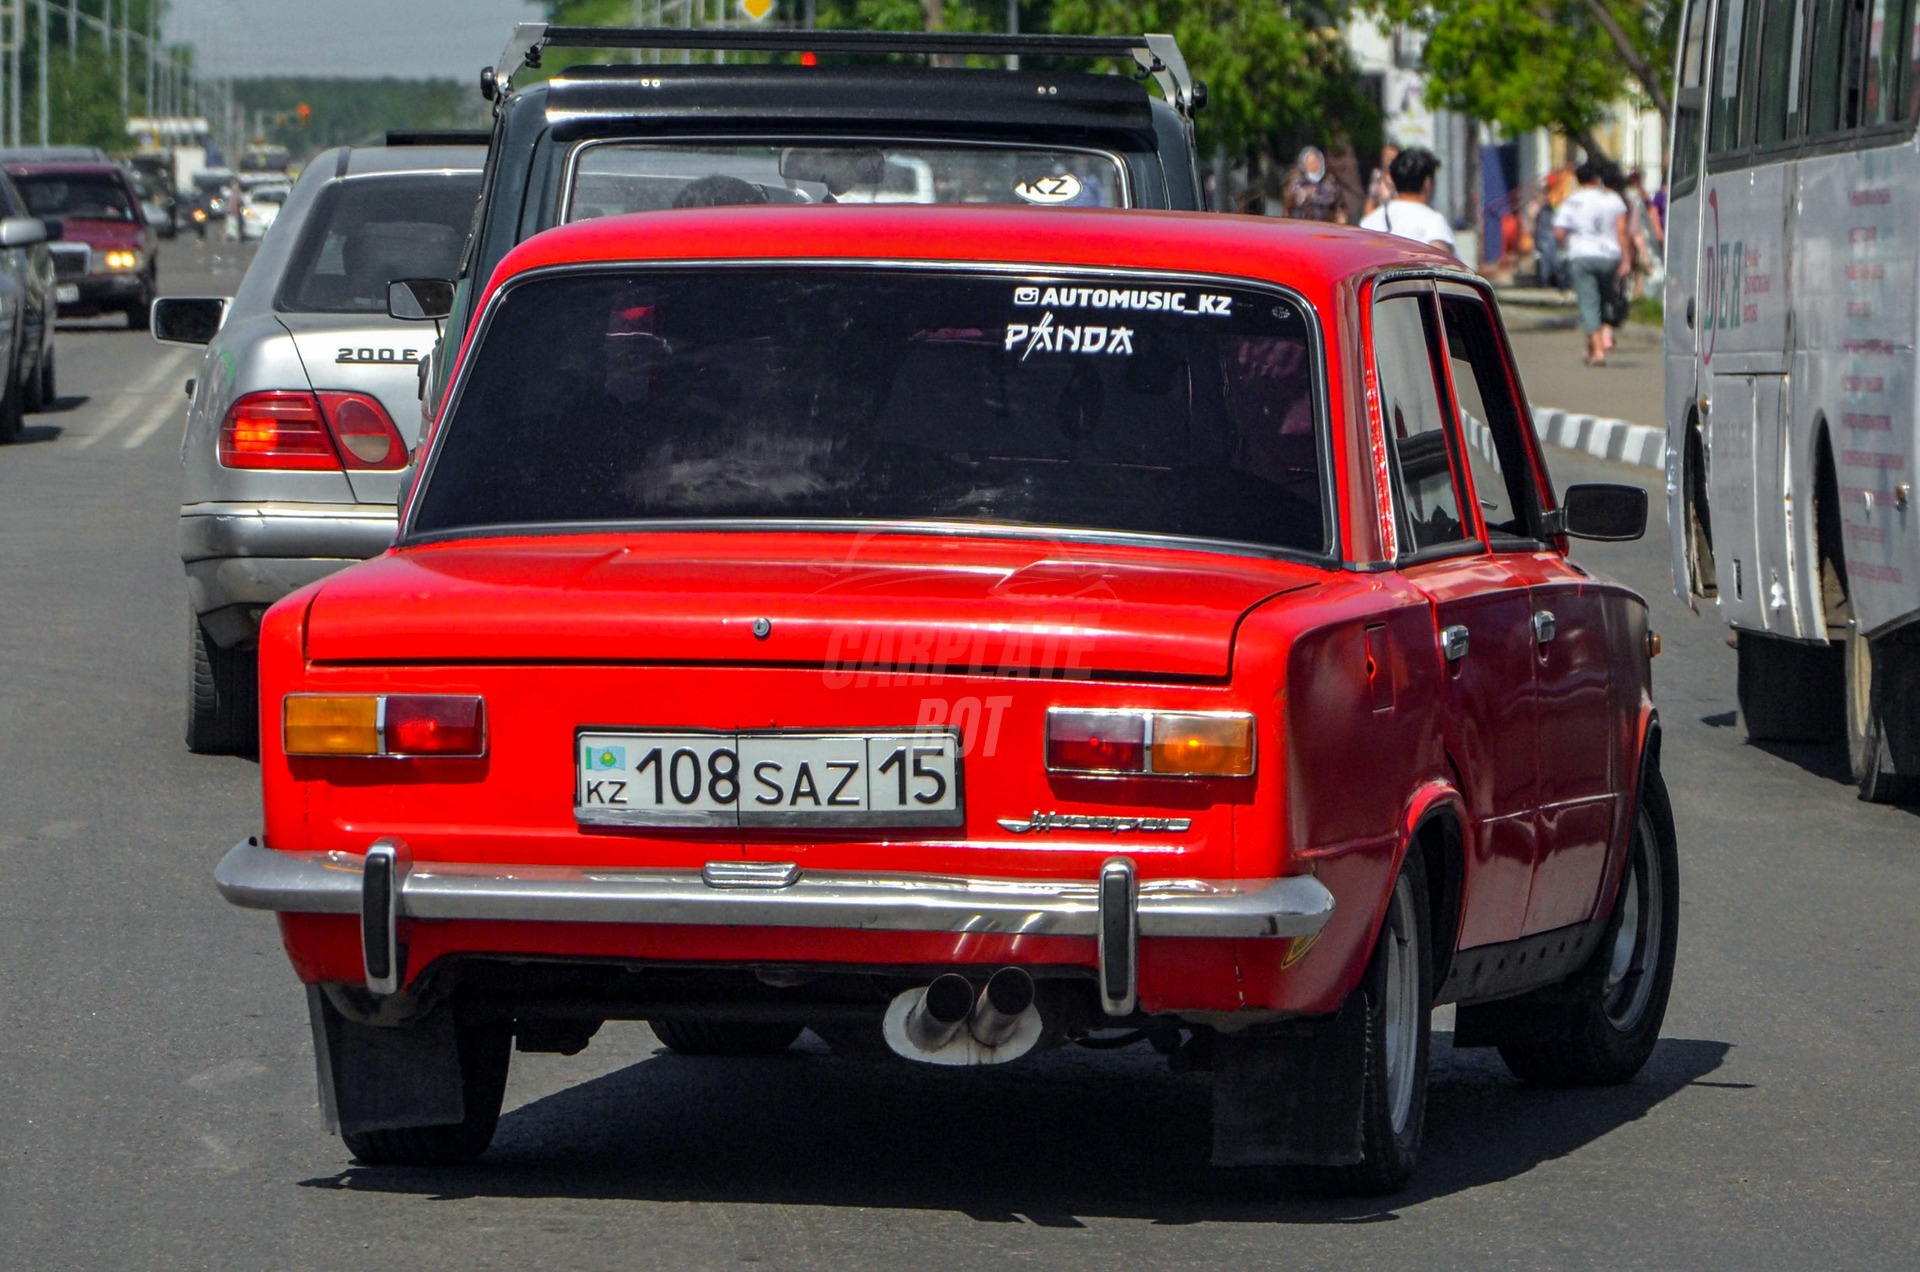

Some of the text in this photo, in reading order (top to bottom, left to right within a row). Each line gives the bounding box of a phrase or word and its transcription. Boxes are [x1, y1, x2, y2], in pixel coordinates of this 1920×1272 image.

[1025, 177, 1068, 195] KZ
[1041, 287, 1231, 316] AUTOMUSIC_KZ
[1004, 312, 1135, 361] PANDA
[338, 348, 418, 361] 200 E
[635, 746, 947, 807] 108 SAZ 15
[586, 779, 628, 804] KZ
